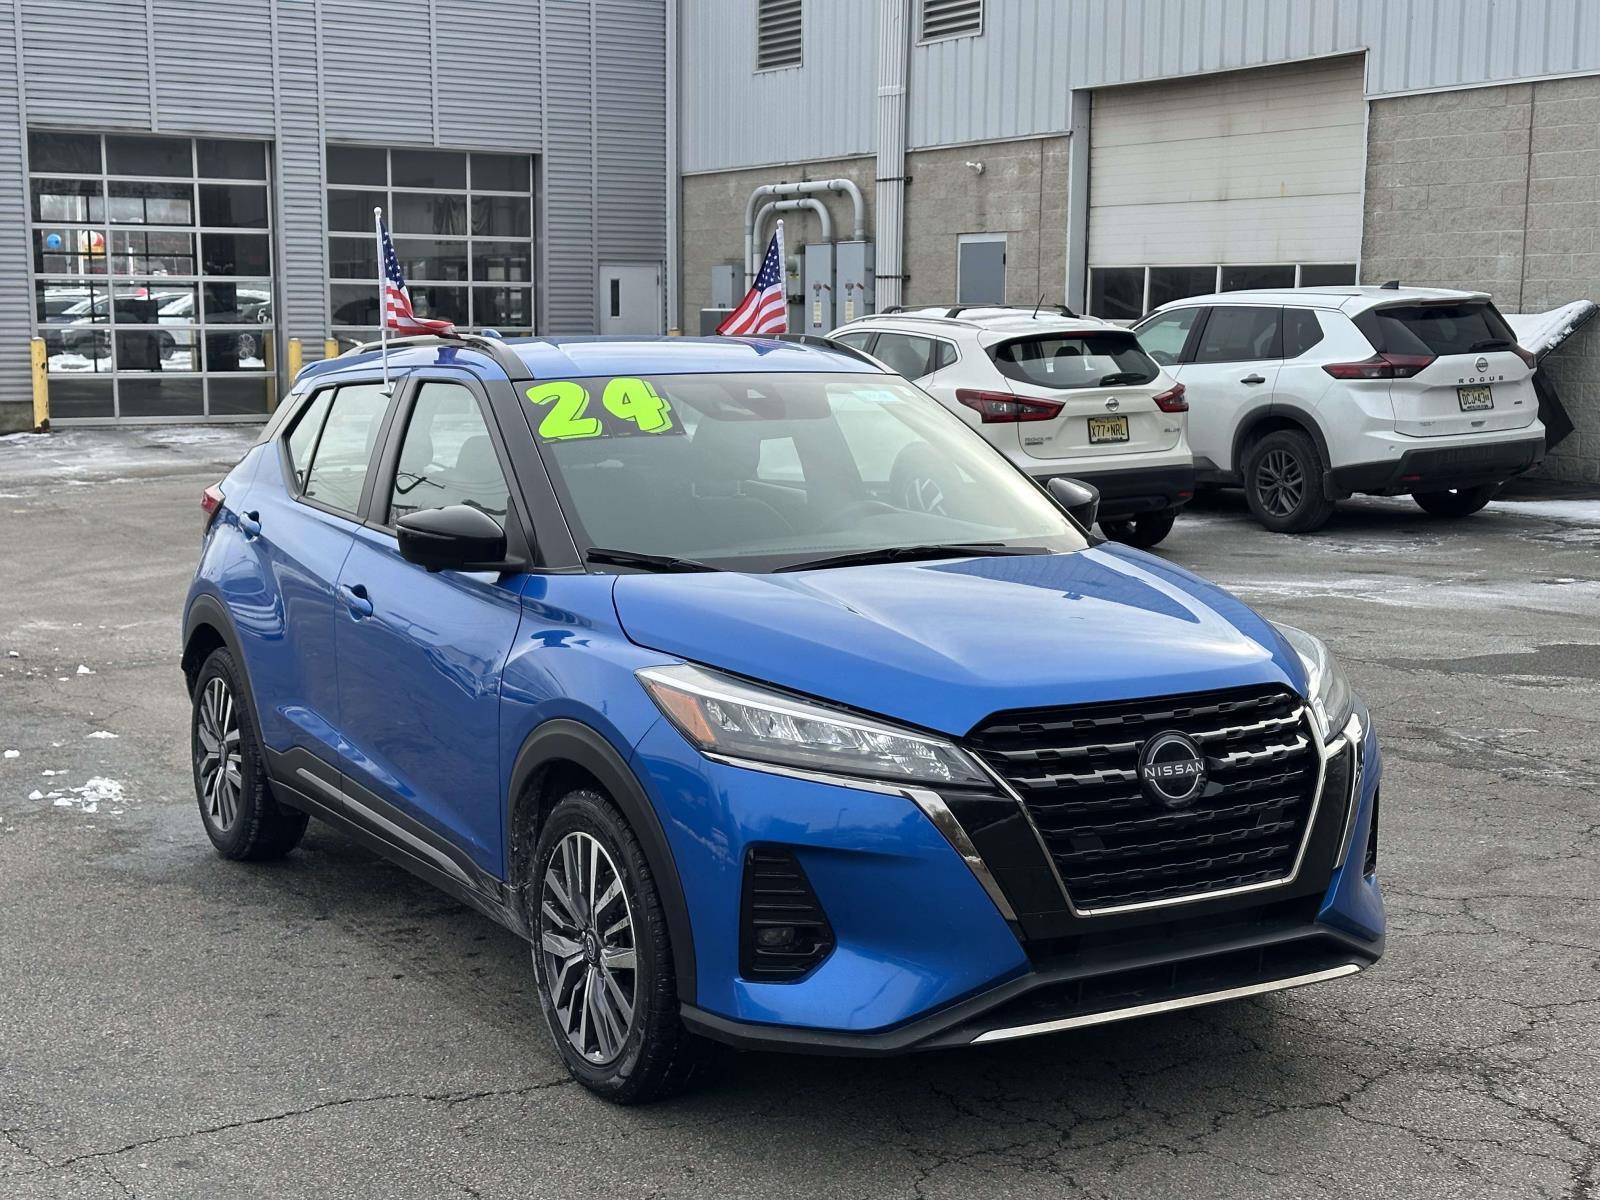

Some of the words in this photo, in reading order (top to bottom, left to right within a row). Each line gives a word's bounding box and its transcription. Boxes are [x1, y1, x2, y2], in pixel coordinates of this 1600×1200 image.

[1458, 375, 1504, 384] ROGUE
[525, 377, 673, 440] 24
[1144, 762, 1204, 777] NISSAN
